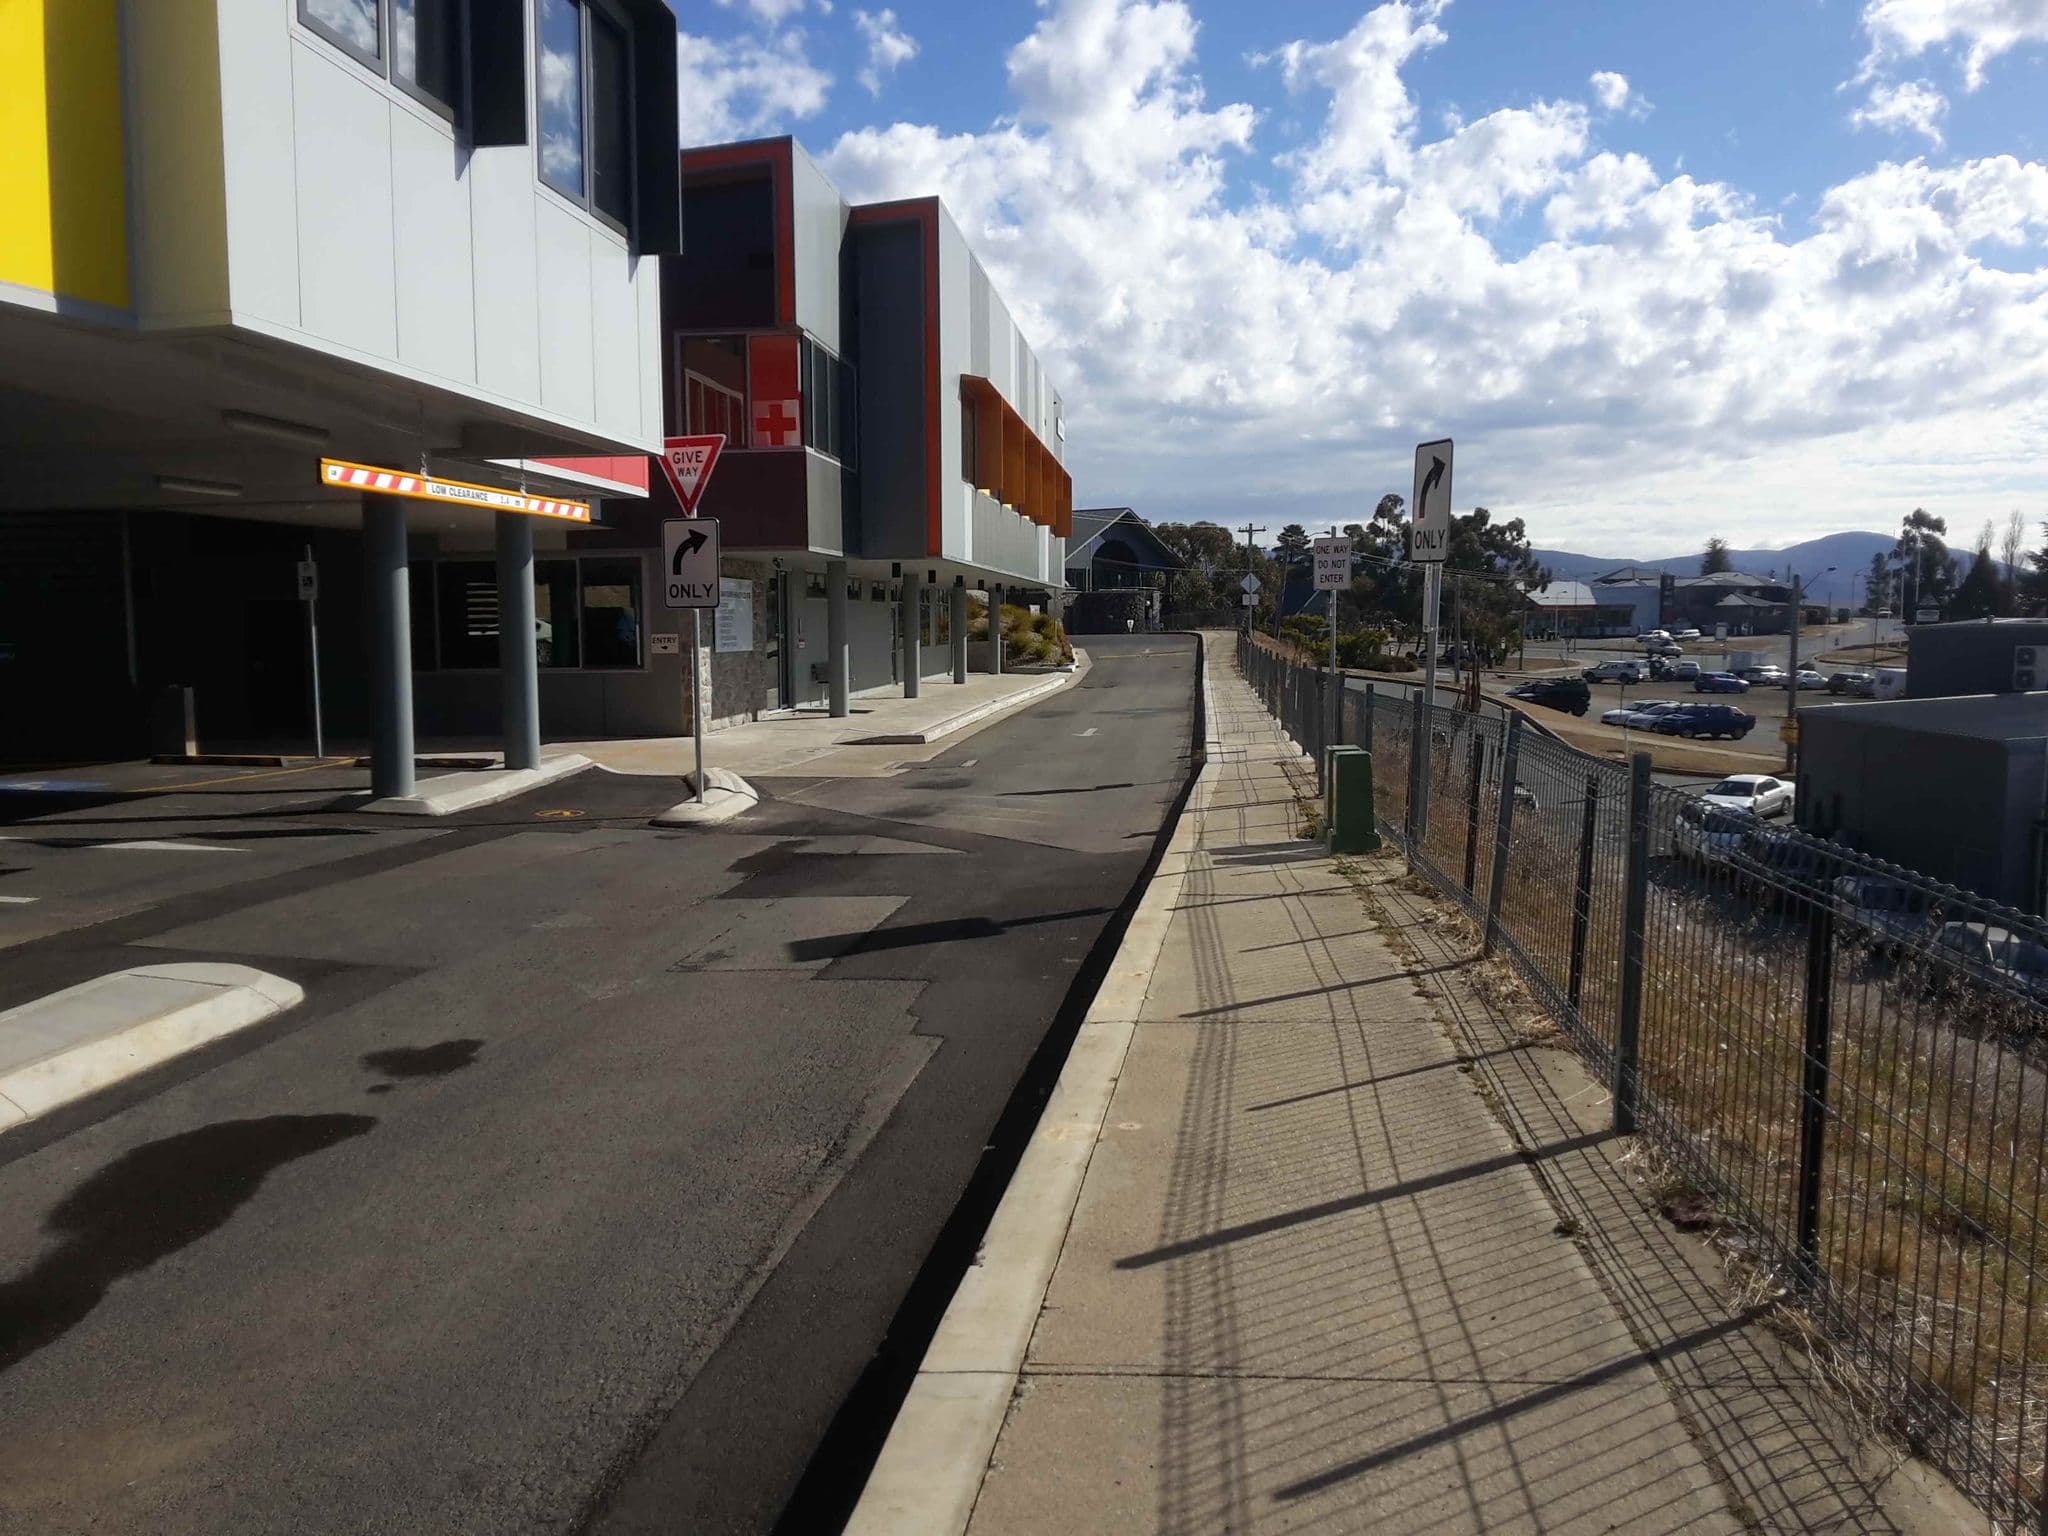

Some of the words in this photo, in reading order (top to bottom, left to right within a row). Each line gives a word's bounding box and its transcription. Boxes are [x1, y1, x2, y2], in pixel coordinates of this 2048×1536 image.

[672, 450, 704, 464] GIVE
[678, 466, 700, 477] WAY
[431, 484, 446, 494] LOW
[449, 487, 488, 501] CLEARANCE
[1414, 529, 1445, 550] ONLY
[1316, 545, 1331, 554] ONE
[1333, 544, 1349, 554] WAY
[1318, 560, 1329, 569] DO
[1331, 560, 1346, 569] NOT
[1320, 574, 1344, 583] ENTER
[669, 583, 714, 599] ONLY
[652, 636, 677, 644] ENTRY
